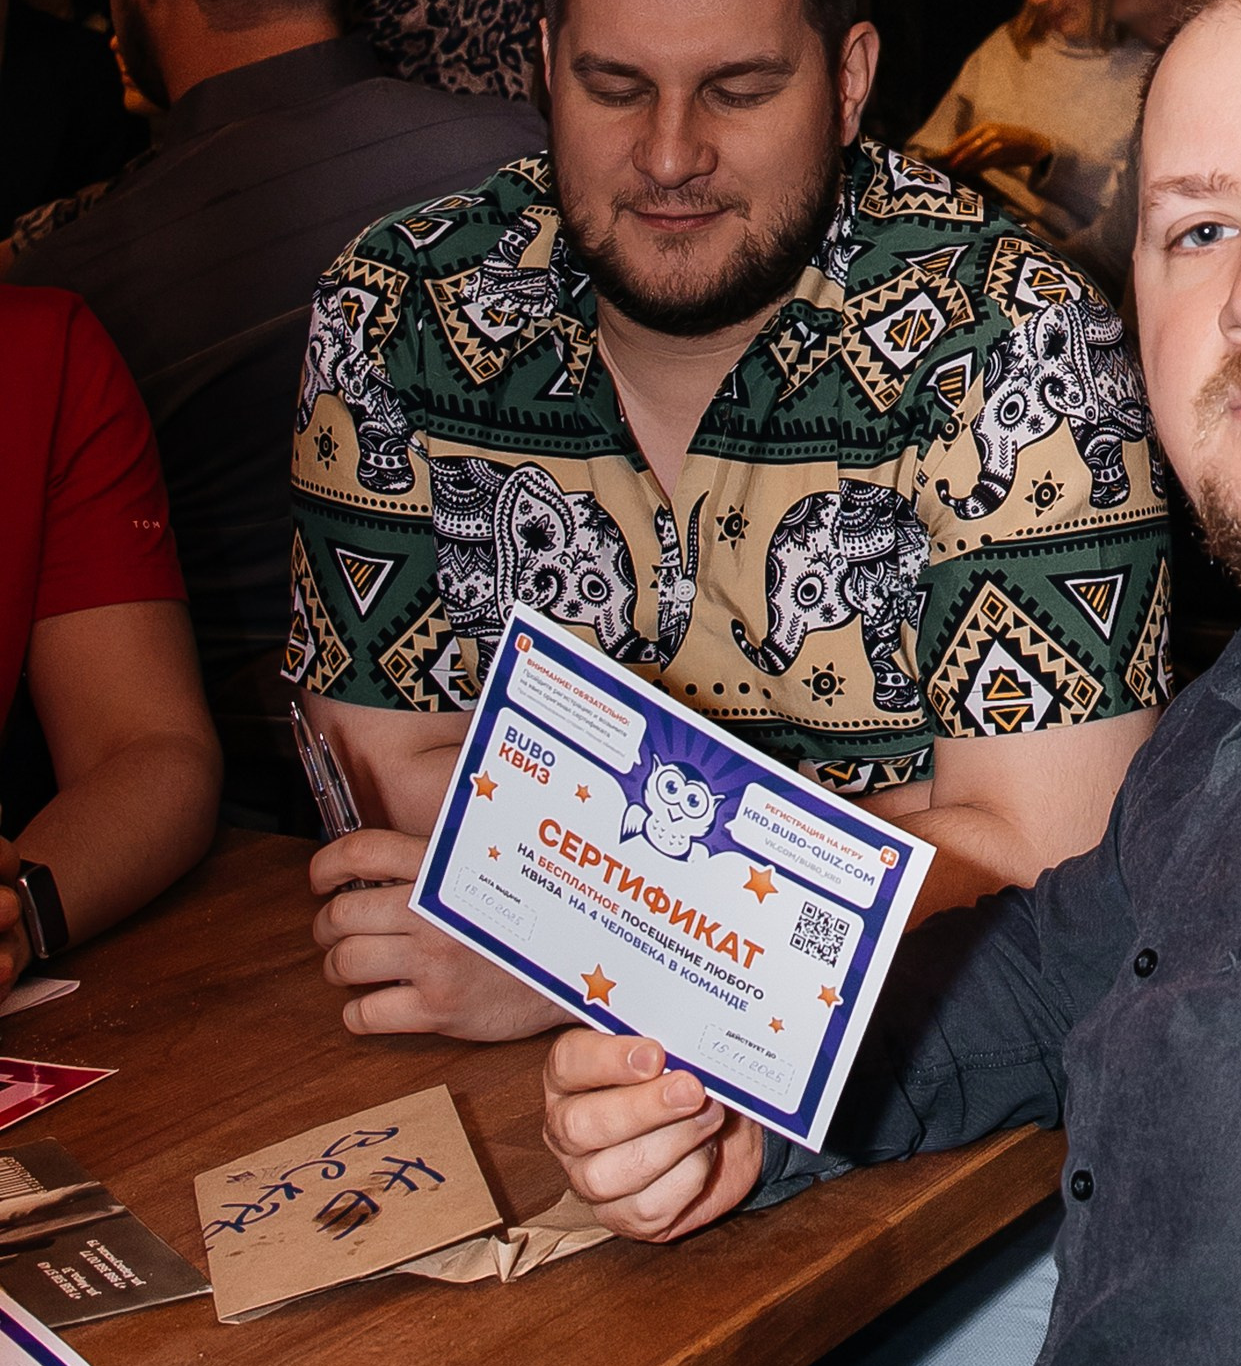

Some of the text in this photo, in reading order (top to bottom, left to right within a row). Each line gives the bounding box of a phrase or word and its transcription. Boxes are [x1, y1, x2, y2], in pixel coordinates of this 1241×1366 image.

[527, 658, 572, 690] ВНИМАНИЕ!
[498, 742, 550, 785] КВИЗ
[505, 726, 556, 767] BUBO
[743, 806, 875, 886] KRD.BUBO-QUIZ.COM
[765, 803, 864, 860] РЕГИСТРАЦИЯ НА ИГРУ
[765, 838, 841, 884] VK.COM/BUBO_KRD
[478, 874, 522, 904] ДАТА ВЫДАЧИ
[538, 818, 765, 969] СЕРТИФИКАТ
[517, 842, 765, 1000] НА БЕСПЛАТНОЕ ПОСЕЩЕНИЕ ЛЮБОГО
[521, 864, 749, 1012] КВИЗА НА 4 ЧЕЛОВЕКА В КОМАНДЕ
[725, 1030, 777, 1060] ДЕЙСТВУЕТ ДО
